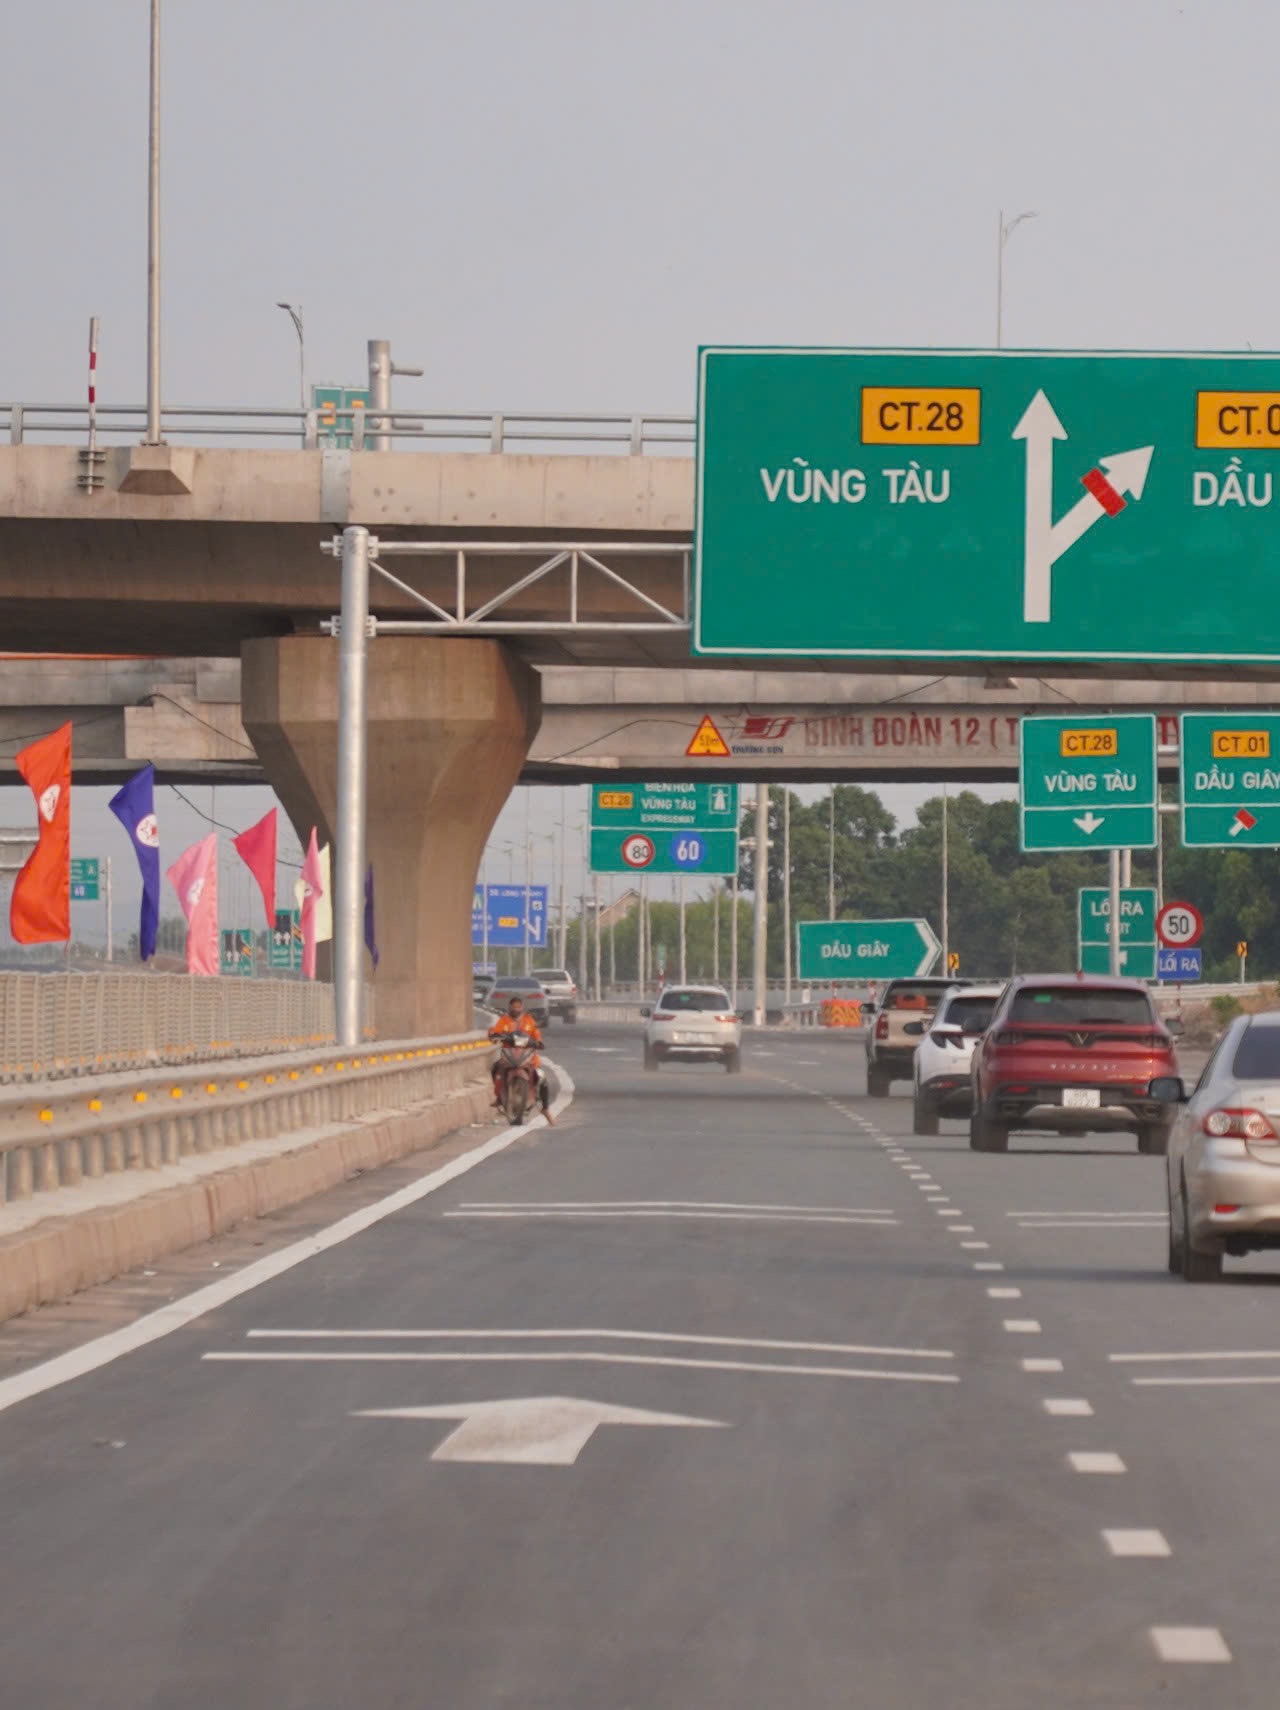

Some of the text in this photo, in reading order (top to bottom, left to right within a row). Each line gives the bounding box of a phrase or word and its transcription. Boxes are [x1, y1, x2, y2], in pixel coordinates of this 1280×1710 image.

[879, 401, 965, 432] CT.28
[760, 457, 951, 503] VŨNG TÀU
[1193, 456, 1273, 507] DẦU
[872, 711, 942, 747] ĐOÀN
[950, 717, 981, 746] 12
[1066, 735, 1112, 751] CT.28
[1217, 736, 1266, 752] CT.01
[1044, 768, 1137, 793] VŨNG TÀU
[1195, 763, 1235, 791] DẦU
[641, 795, 696, 811] VŨNG TÀU
[632, 846, 649, 859] 80
[677, 840, 700, 861] 60
[1091, 898, 1144, 916] LỐ RA
[1105, 922, 1131, 934] EIT
[1169, 916, 1189, 935] 50
[1159, 952, 1199, 972] LỐI RA
